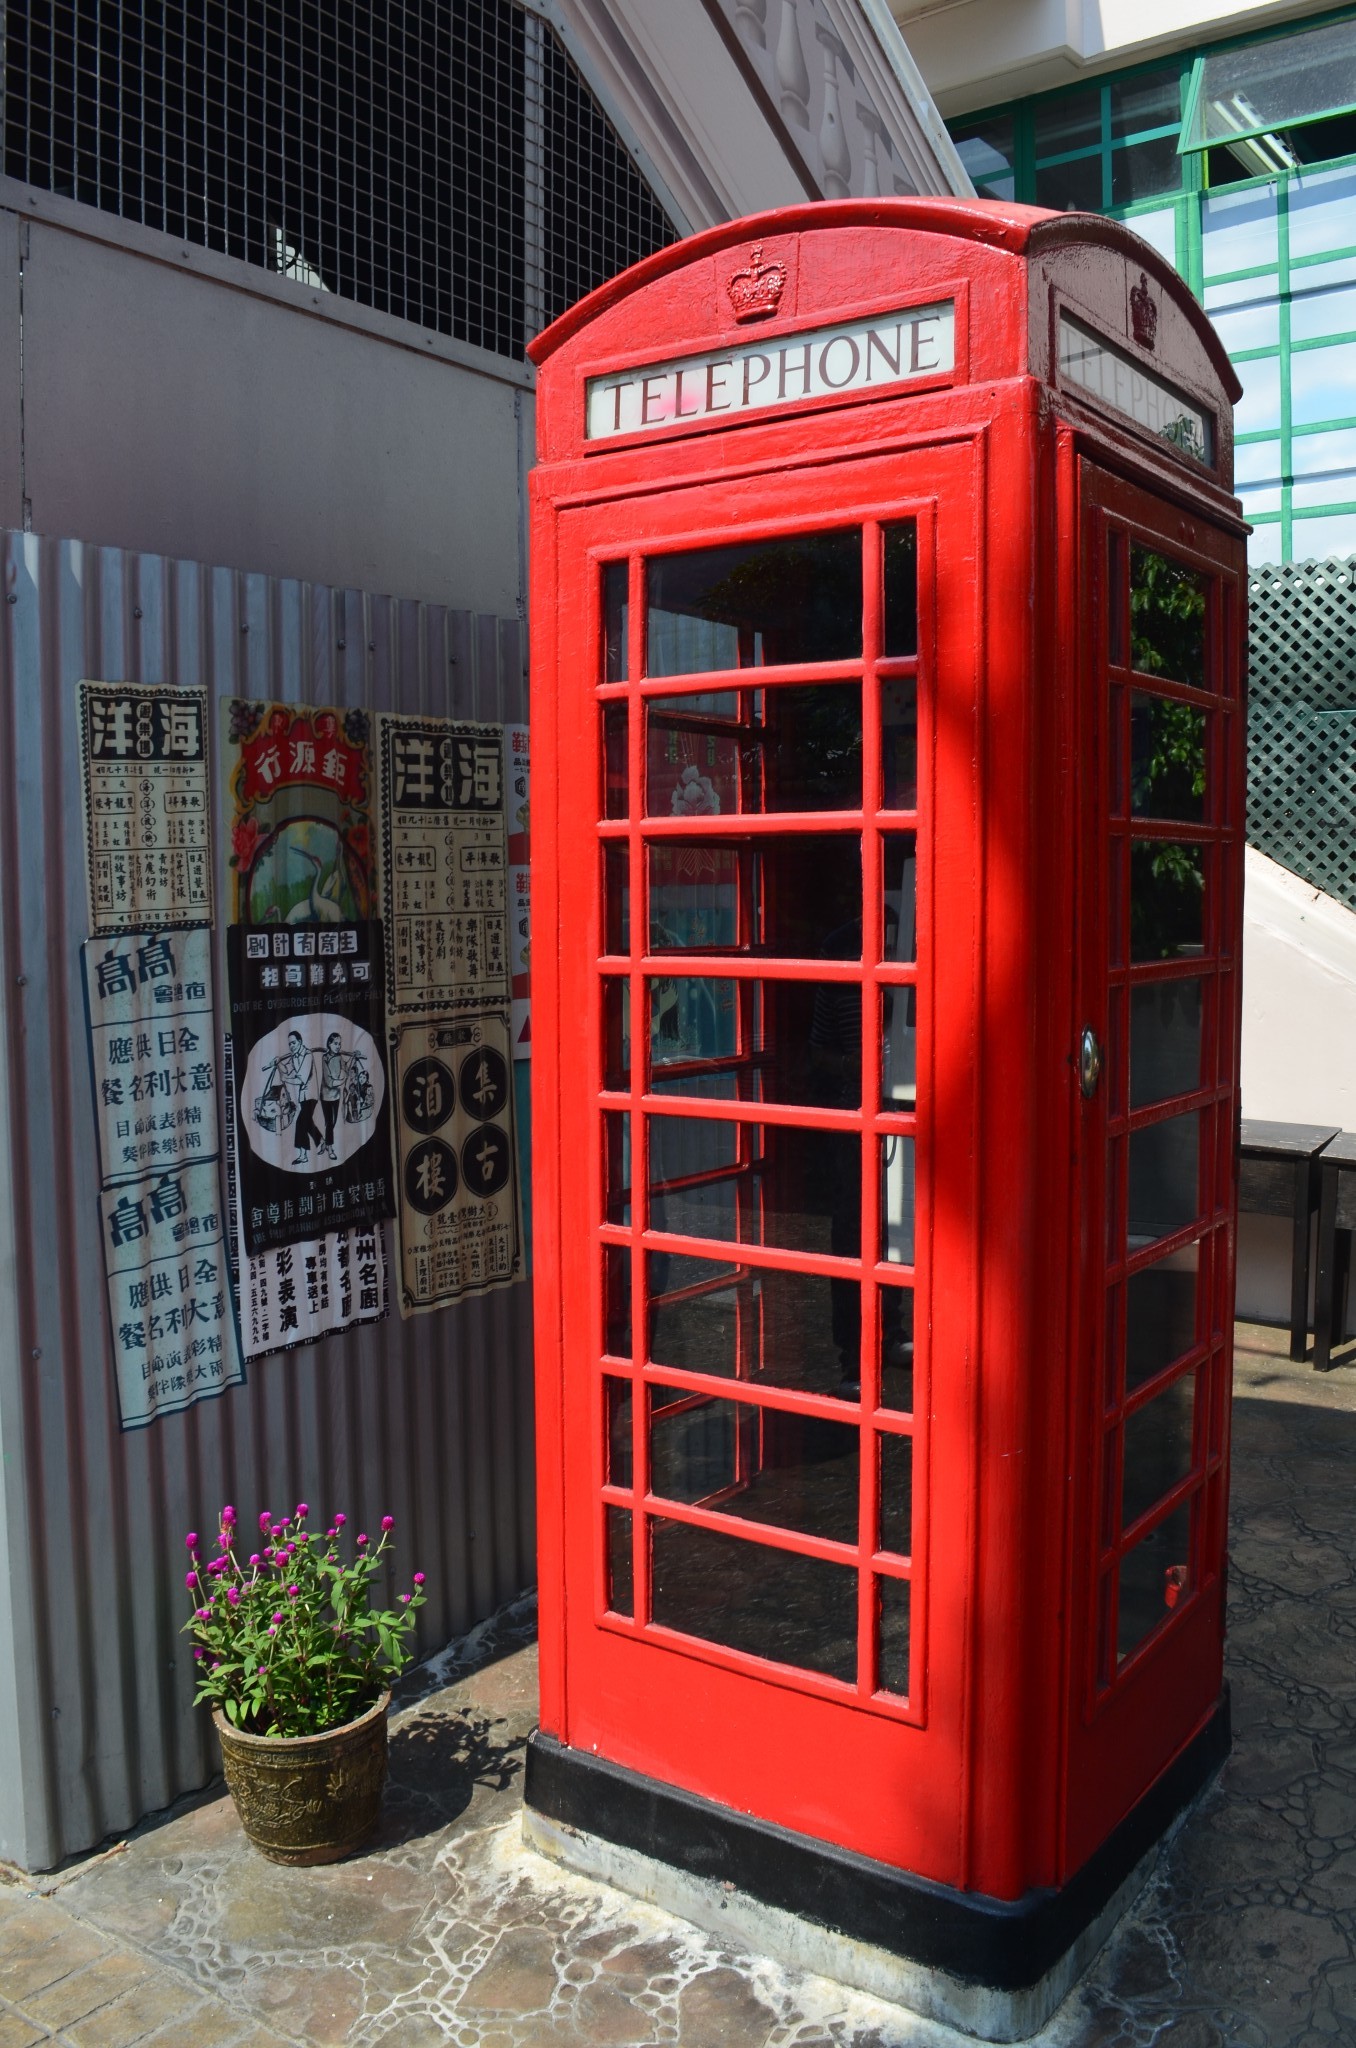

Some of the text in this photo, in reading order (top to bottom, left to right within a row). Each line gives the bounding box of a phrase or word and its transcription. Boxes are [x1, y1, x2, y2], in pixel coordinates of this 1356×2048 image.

[603, 315, 944, 431] TELEPHONE
[1061, 322, 1202, 452] TELEPHO
[248, 932, 356, 957] 生育有計劃
